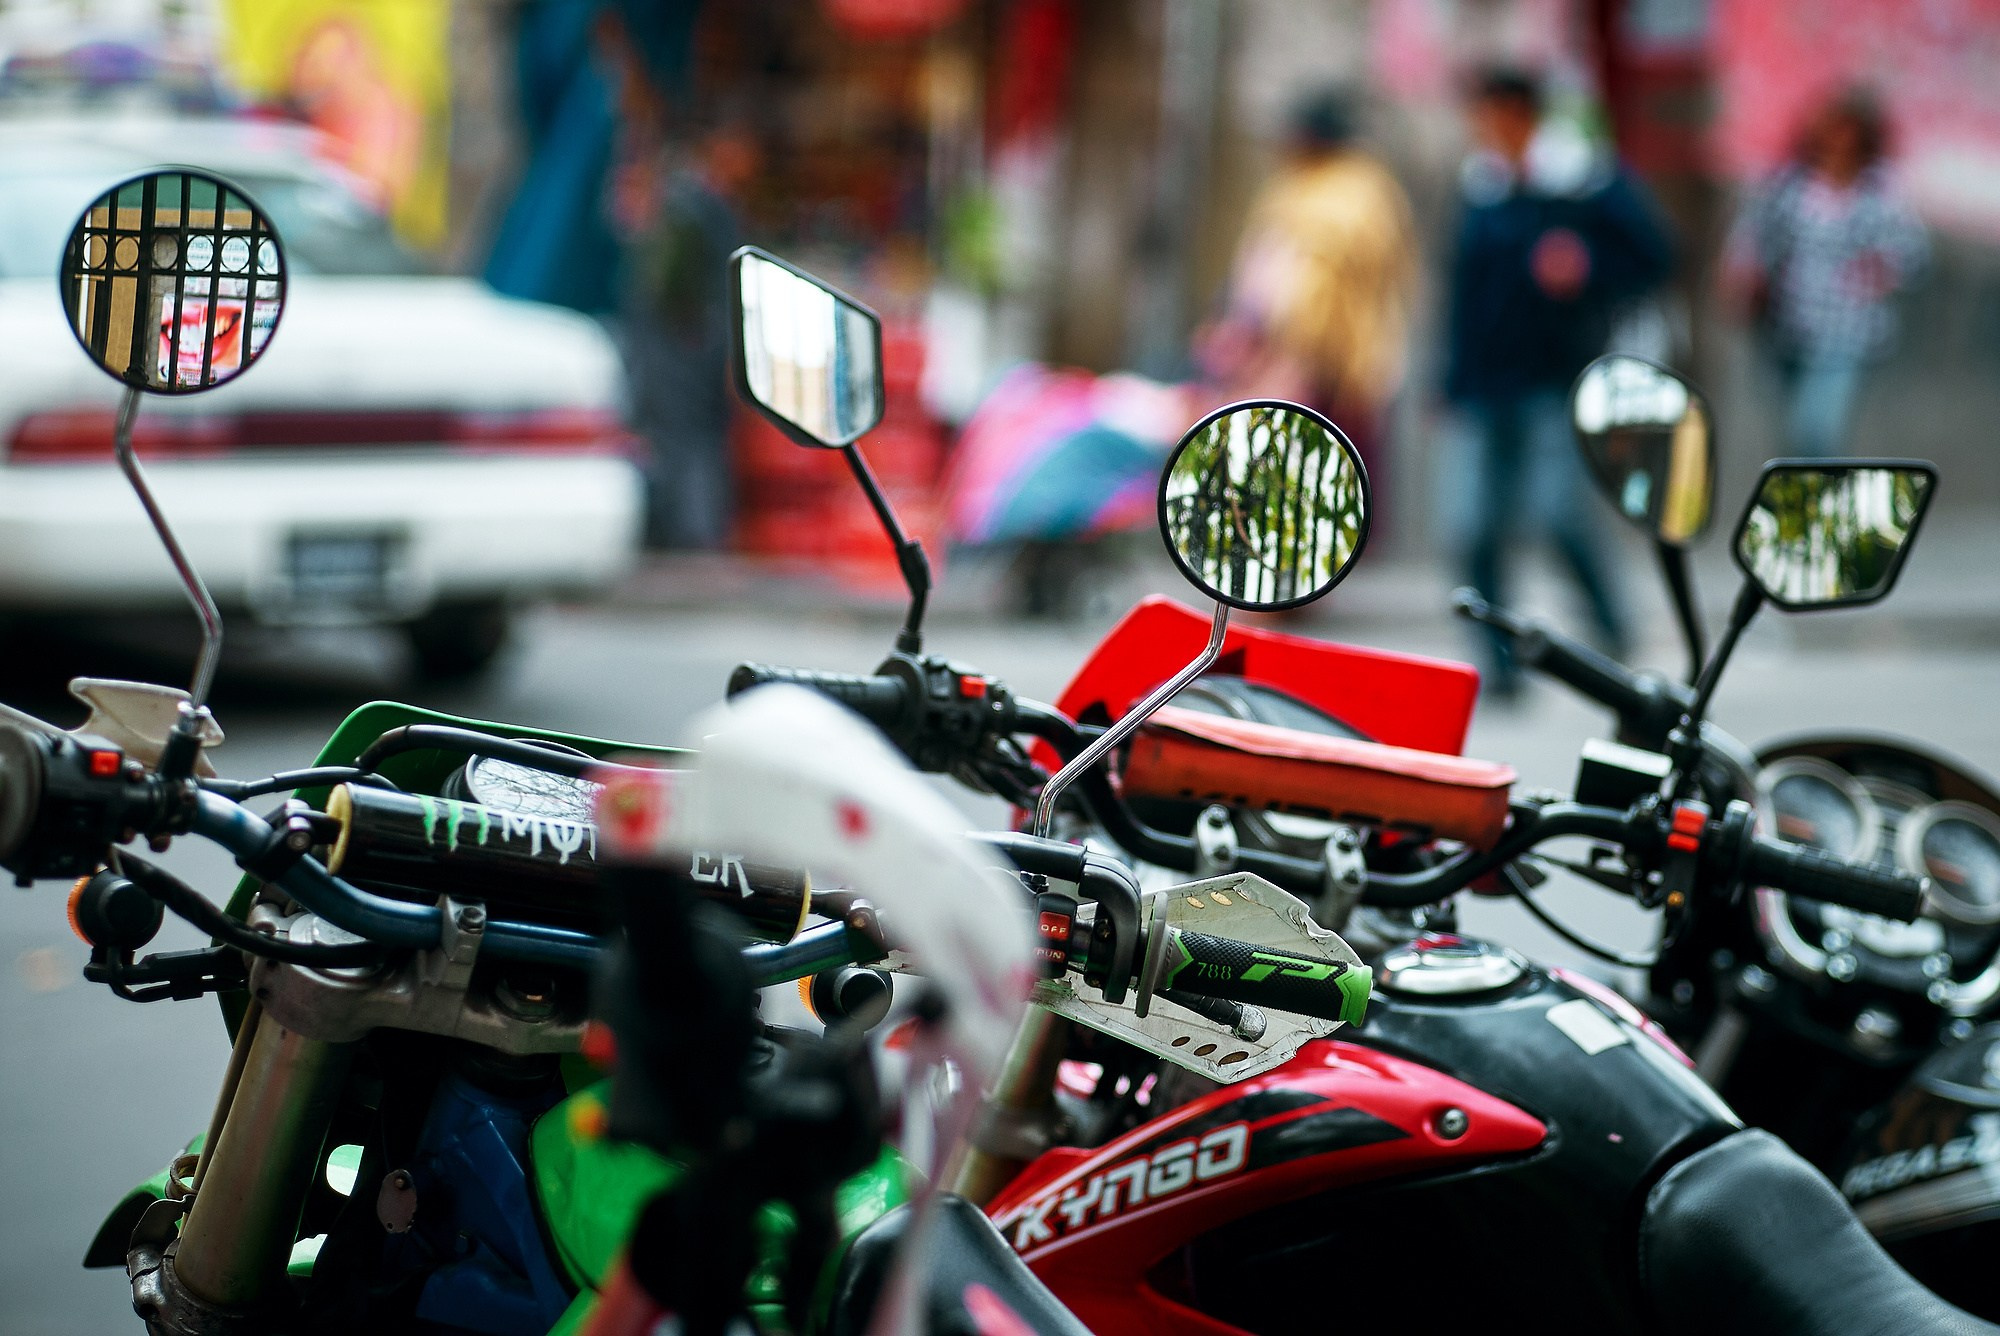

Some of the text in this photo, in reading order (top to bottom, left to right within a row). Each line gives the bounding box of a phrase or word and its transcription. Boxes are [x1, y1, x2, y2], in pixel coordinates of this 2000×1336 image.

[1040, 924, 1067, 934] OFF
[1036, 948, 1062, 959] RUN
[1197, 962, 1232, 981] 788
[1014, 1124, 1248, 1250] KYNGO
